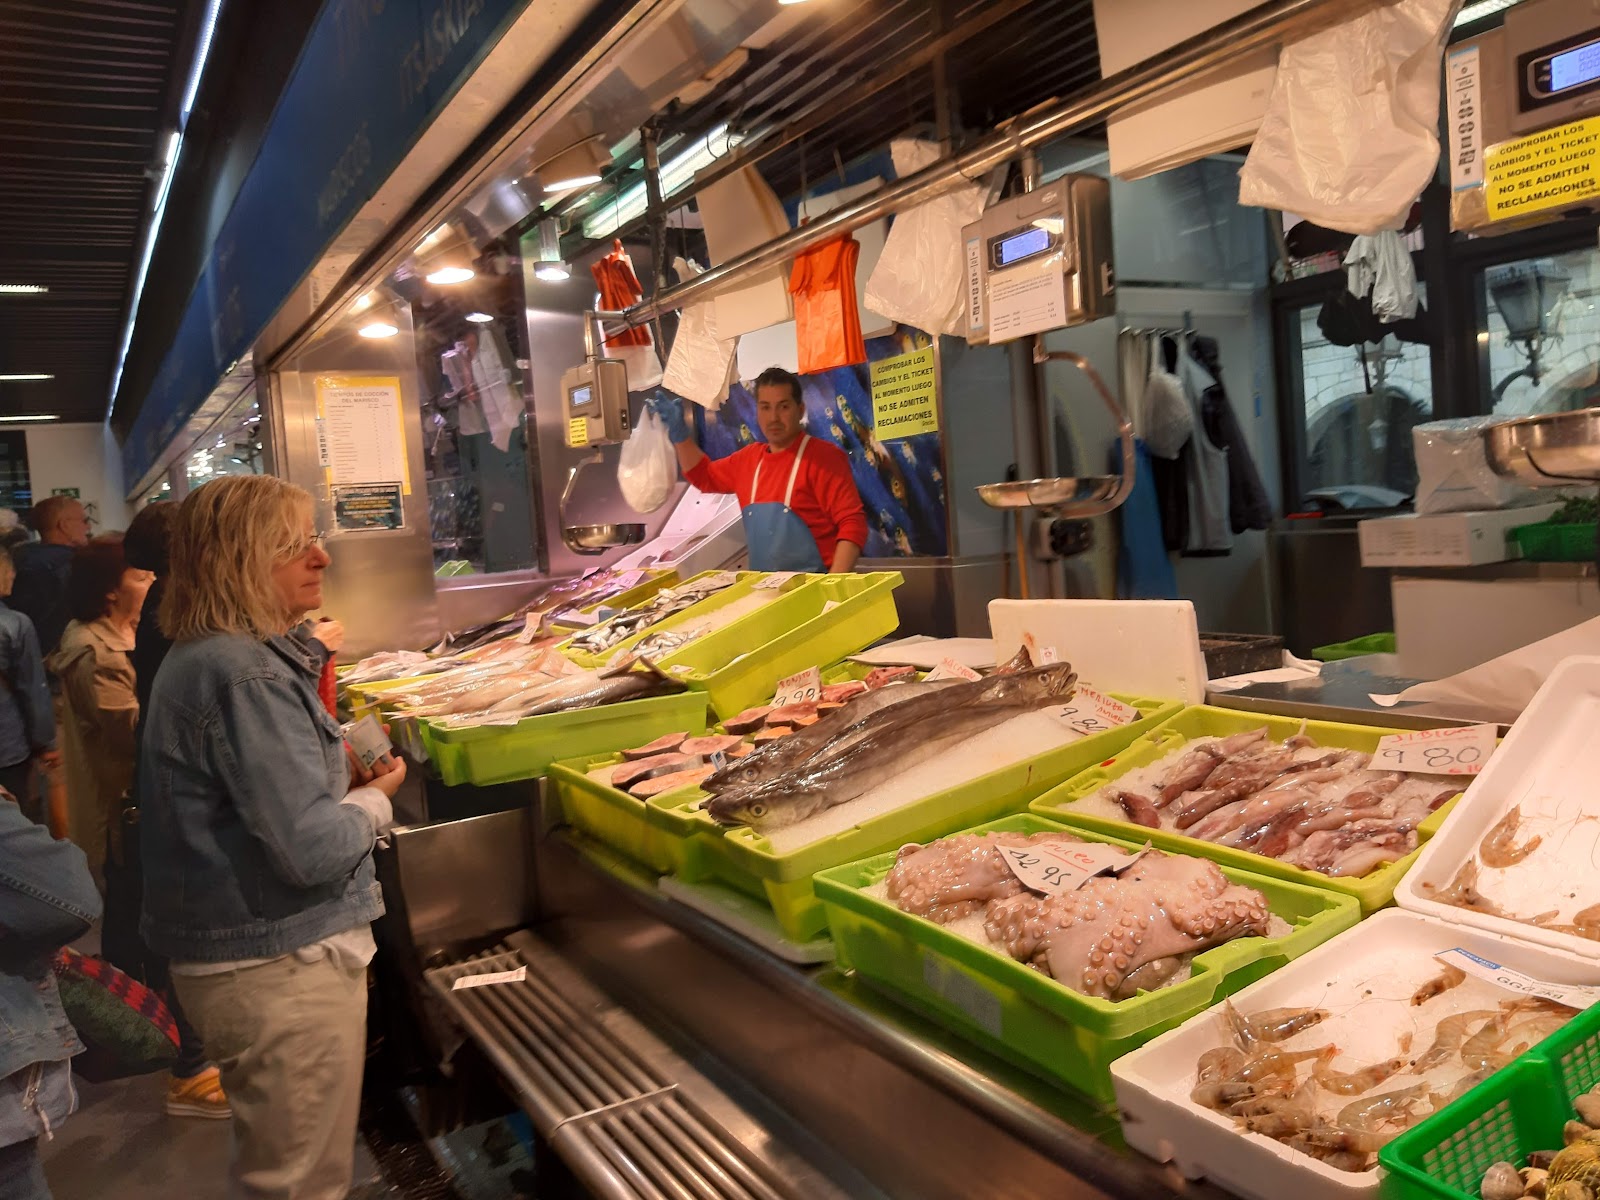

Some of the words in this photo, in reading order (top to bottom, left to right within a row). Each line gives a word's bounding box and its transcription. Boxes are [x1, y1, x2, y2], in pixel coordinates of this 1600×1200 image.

[1489, 153, 1532, 171] CAMBIOS
[1544, 147, 1557, 155] EL
[1559, 133, 1600, 150] TICKET
[1500, 131, 1560, 155] COMPROBAR
[1563, 124, 1585, 136] LOS
[1493, 174, 1504, 182] AL
[1506, 159, 1557, 178] MOMENTO
[1559, 148, 1596, 163] LUEGO
[1499, 184, 1515, 195] NO
[1518, 179, 1533, 189] SE
[1536, 163, 1590, 185] ADMITEN
[1497, 177, 1596, 210] RECLAMACIONES
[872, 376, 896, 388] CAMBIOS
[911, 367, 934, 378] TICKET
[877, 359, 913, 374] COMPROBAR
[913, 356, 926, 365] LOS
[882, 386, 911, 398] MOMENTO
[911, 381, 933, 391] LUEGO
[878, 404, 888, 413] NO
[889, 402, 897, 410] SE
[899, 395, 929, 409] ADMITEN
[877, 410, 933, 428] RECLAMACIONES
